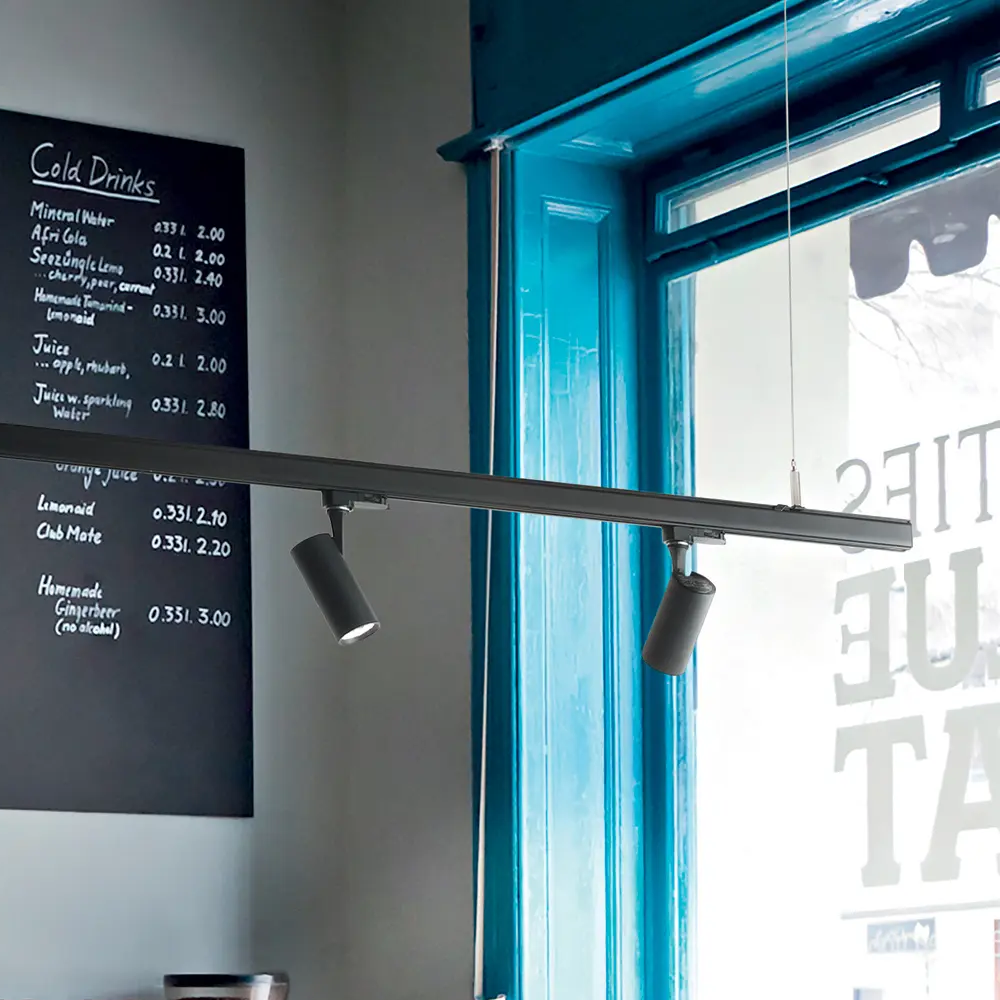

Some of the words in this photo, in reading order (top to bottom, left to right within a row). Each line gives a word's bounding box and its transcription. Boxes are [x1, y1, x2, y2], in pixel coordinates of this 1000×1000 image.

[30, 142, 82, 182] Cold
[89, 155, 156, 196] Drinks
[30, 200, 81, 223] Mineral
[83, 209, 115, 227] Water
[197, 226, 225, 241] 2.00
[31, 223, 60, 245] Afri
[62, 227, 88, 246] Cola
[195, 249, 225, 265] 2.00
[195, 269, 223, 288] 2.40
[196, 307, 226, 325] 3.00
[32, 333, 70, 356] Juice
[197, 355, 227, 374] 2.00
[33, 382, 65, 405] Juice
[84, 393, 133, 418] sparkling
[197, 399, 226, 419] 2.80
[52, 405, 90, 420] Water
[37, 494, 96, 516] Lemonaid
[196, 507, 227, 527] 2.10
[36, 522, 64, 540] Club
[66, 525, 102, 544] Mate
[197, 538, 231, 557] 2.20
[38, 575, 103, 599] Homemade
[55, 598, 121, 622] Gingerbeer
[198, 607, 231, 627] 3.00
[55, 618, 77, 635] (no
